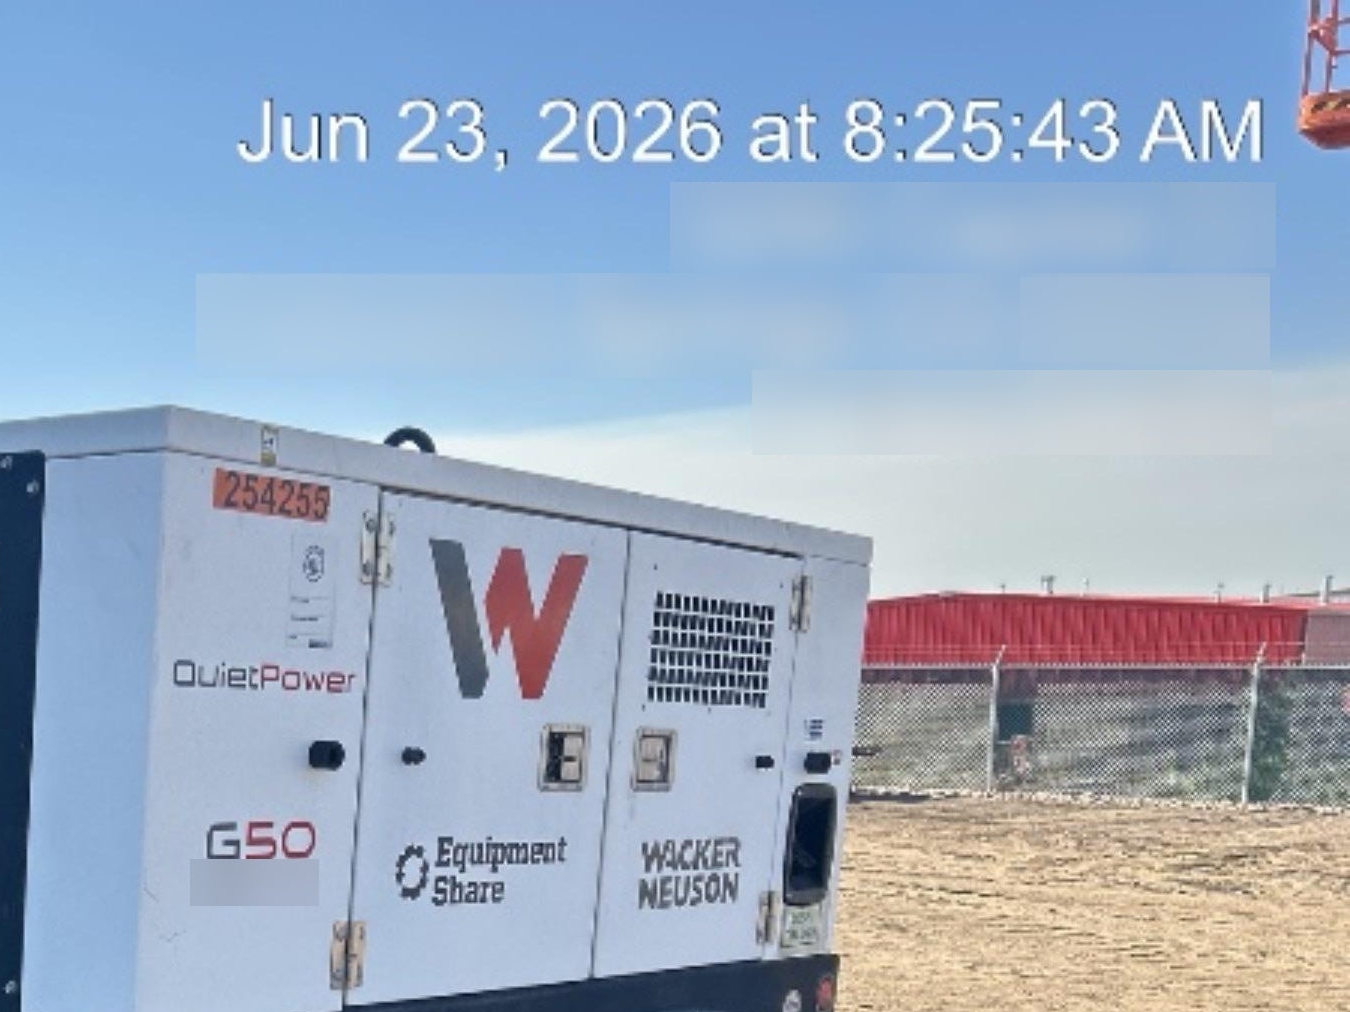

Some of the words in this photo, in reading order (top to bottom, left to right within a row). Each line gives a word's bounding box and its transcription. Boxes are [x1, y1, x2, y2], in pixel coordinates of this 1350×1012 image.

[223, 469, 330, 520] 254255
[172, 658, 357, 694] QuietPower
[206, 820, 317, 860] G50
[435, 835, 568, 873] Equipment
[641, 836, 741, 873] WACKER
[431, 874, 505, 907] Share
[637, 871, 740, 910] NEUSON
